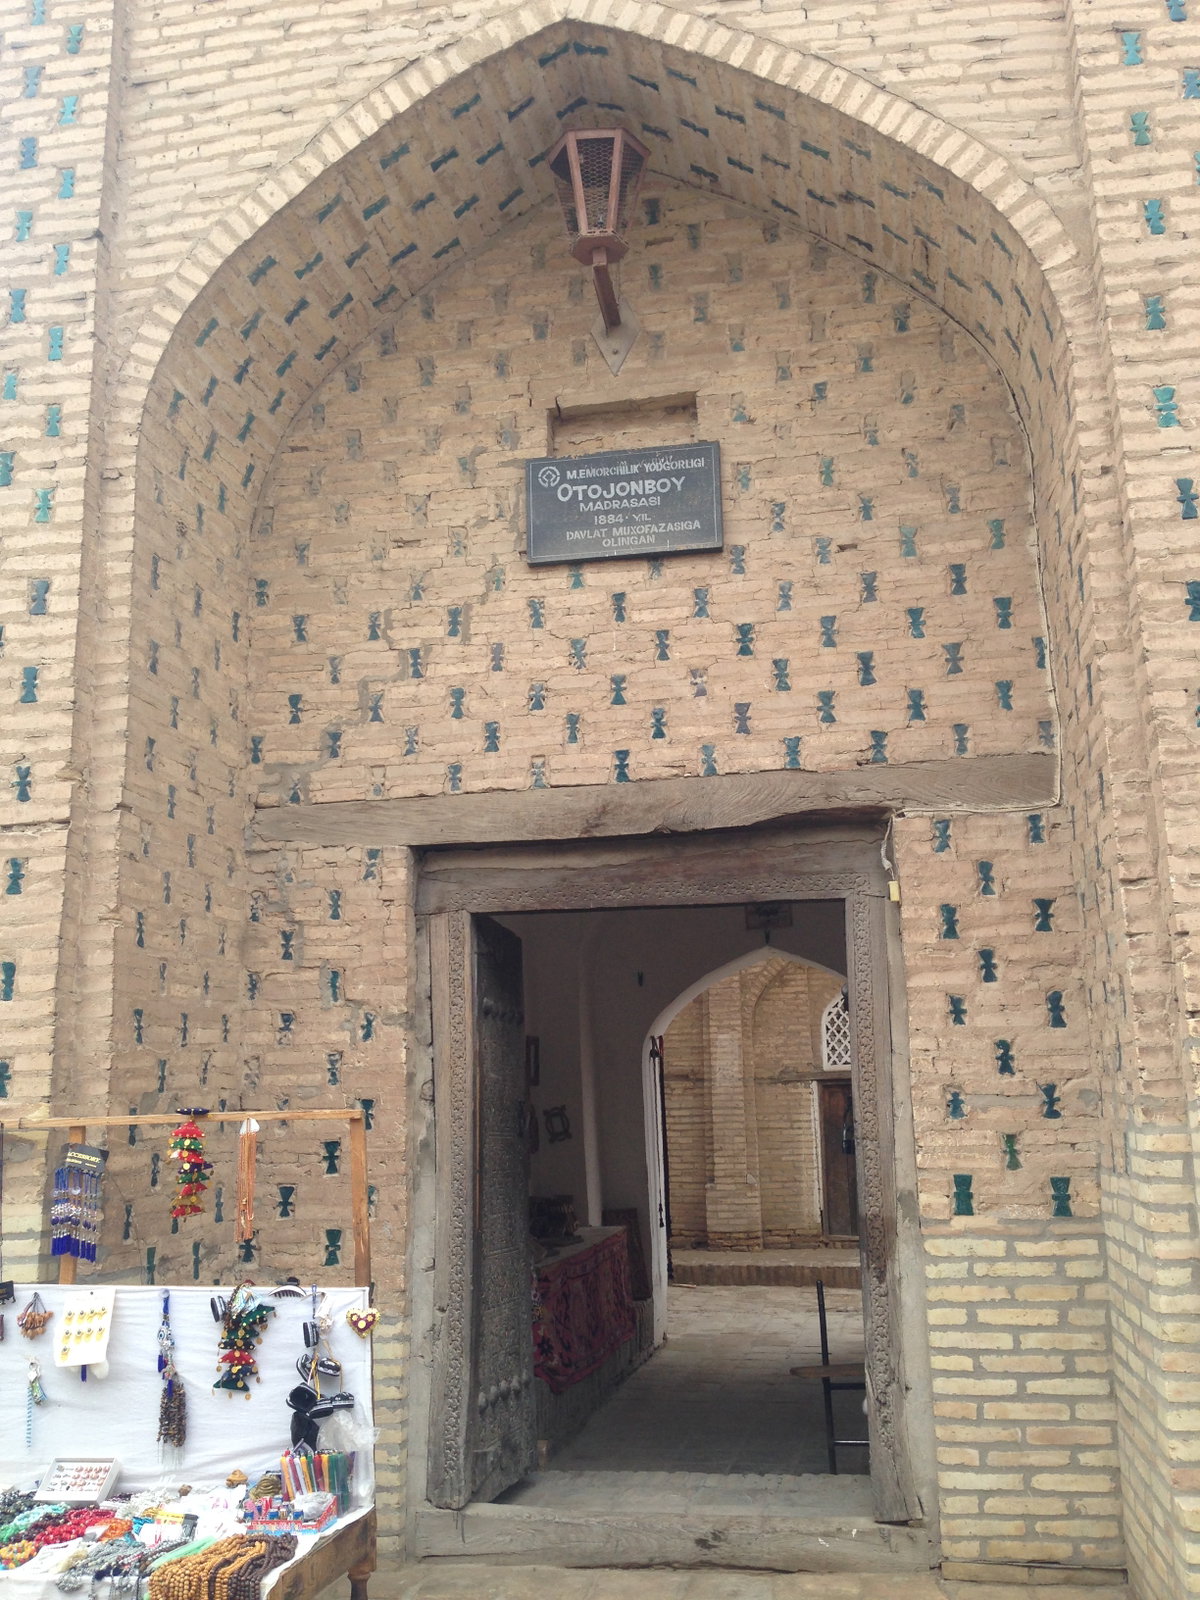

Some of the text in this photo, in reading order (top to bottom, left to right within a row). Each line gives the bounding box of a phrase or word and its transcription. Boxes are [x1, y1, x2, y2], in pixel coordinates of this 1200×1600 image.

[643, 457, 705, 472] YODGORLIGI
[557, 476, 686, 502] OTOJONBOY
[579, 496, 661, 513] MADRASASI
[632, 513, 652, 523] YIL
[566, 519, 701, 541] DAVLAT MUXOFAZASIGA
[602, 535, 655, 548] OLINGAN
